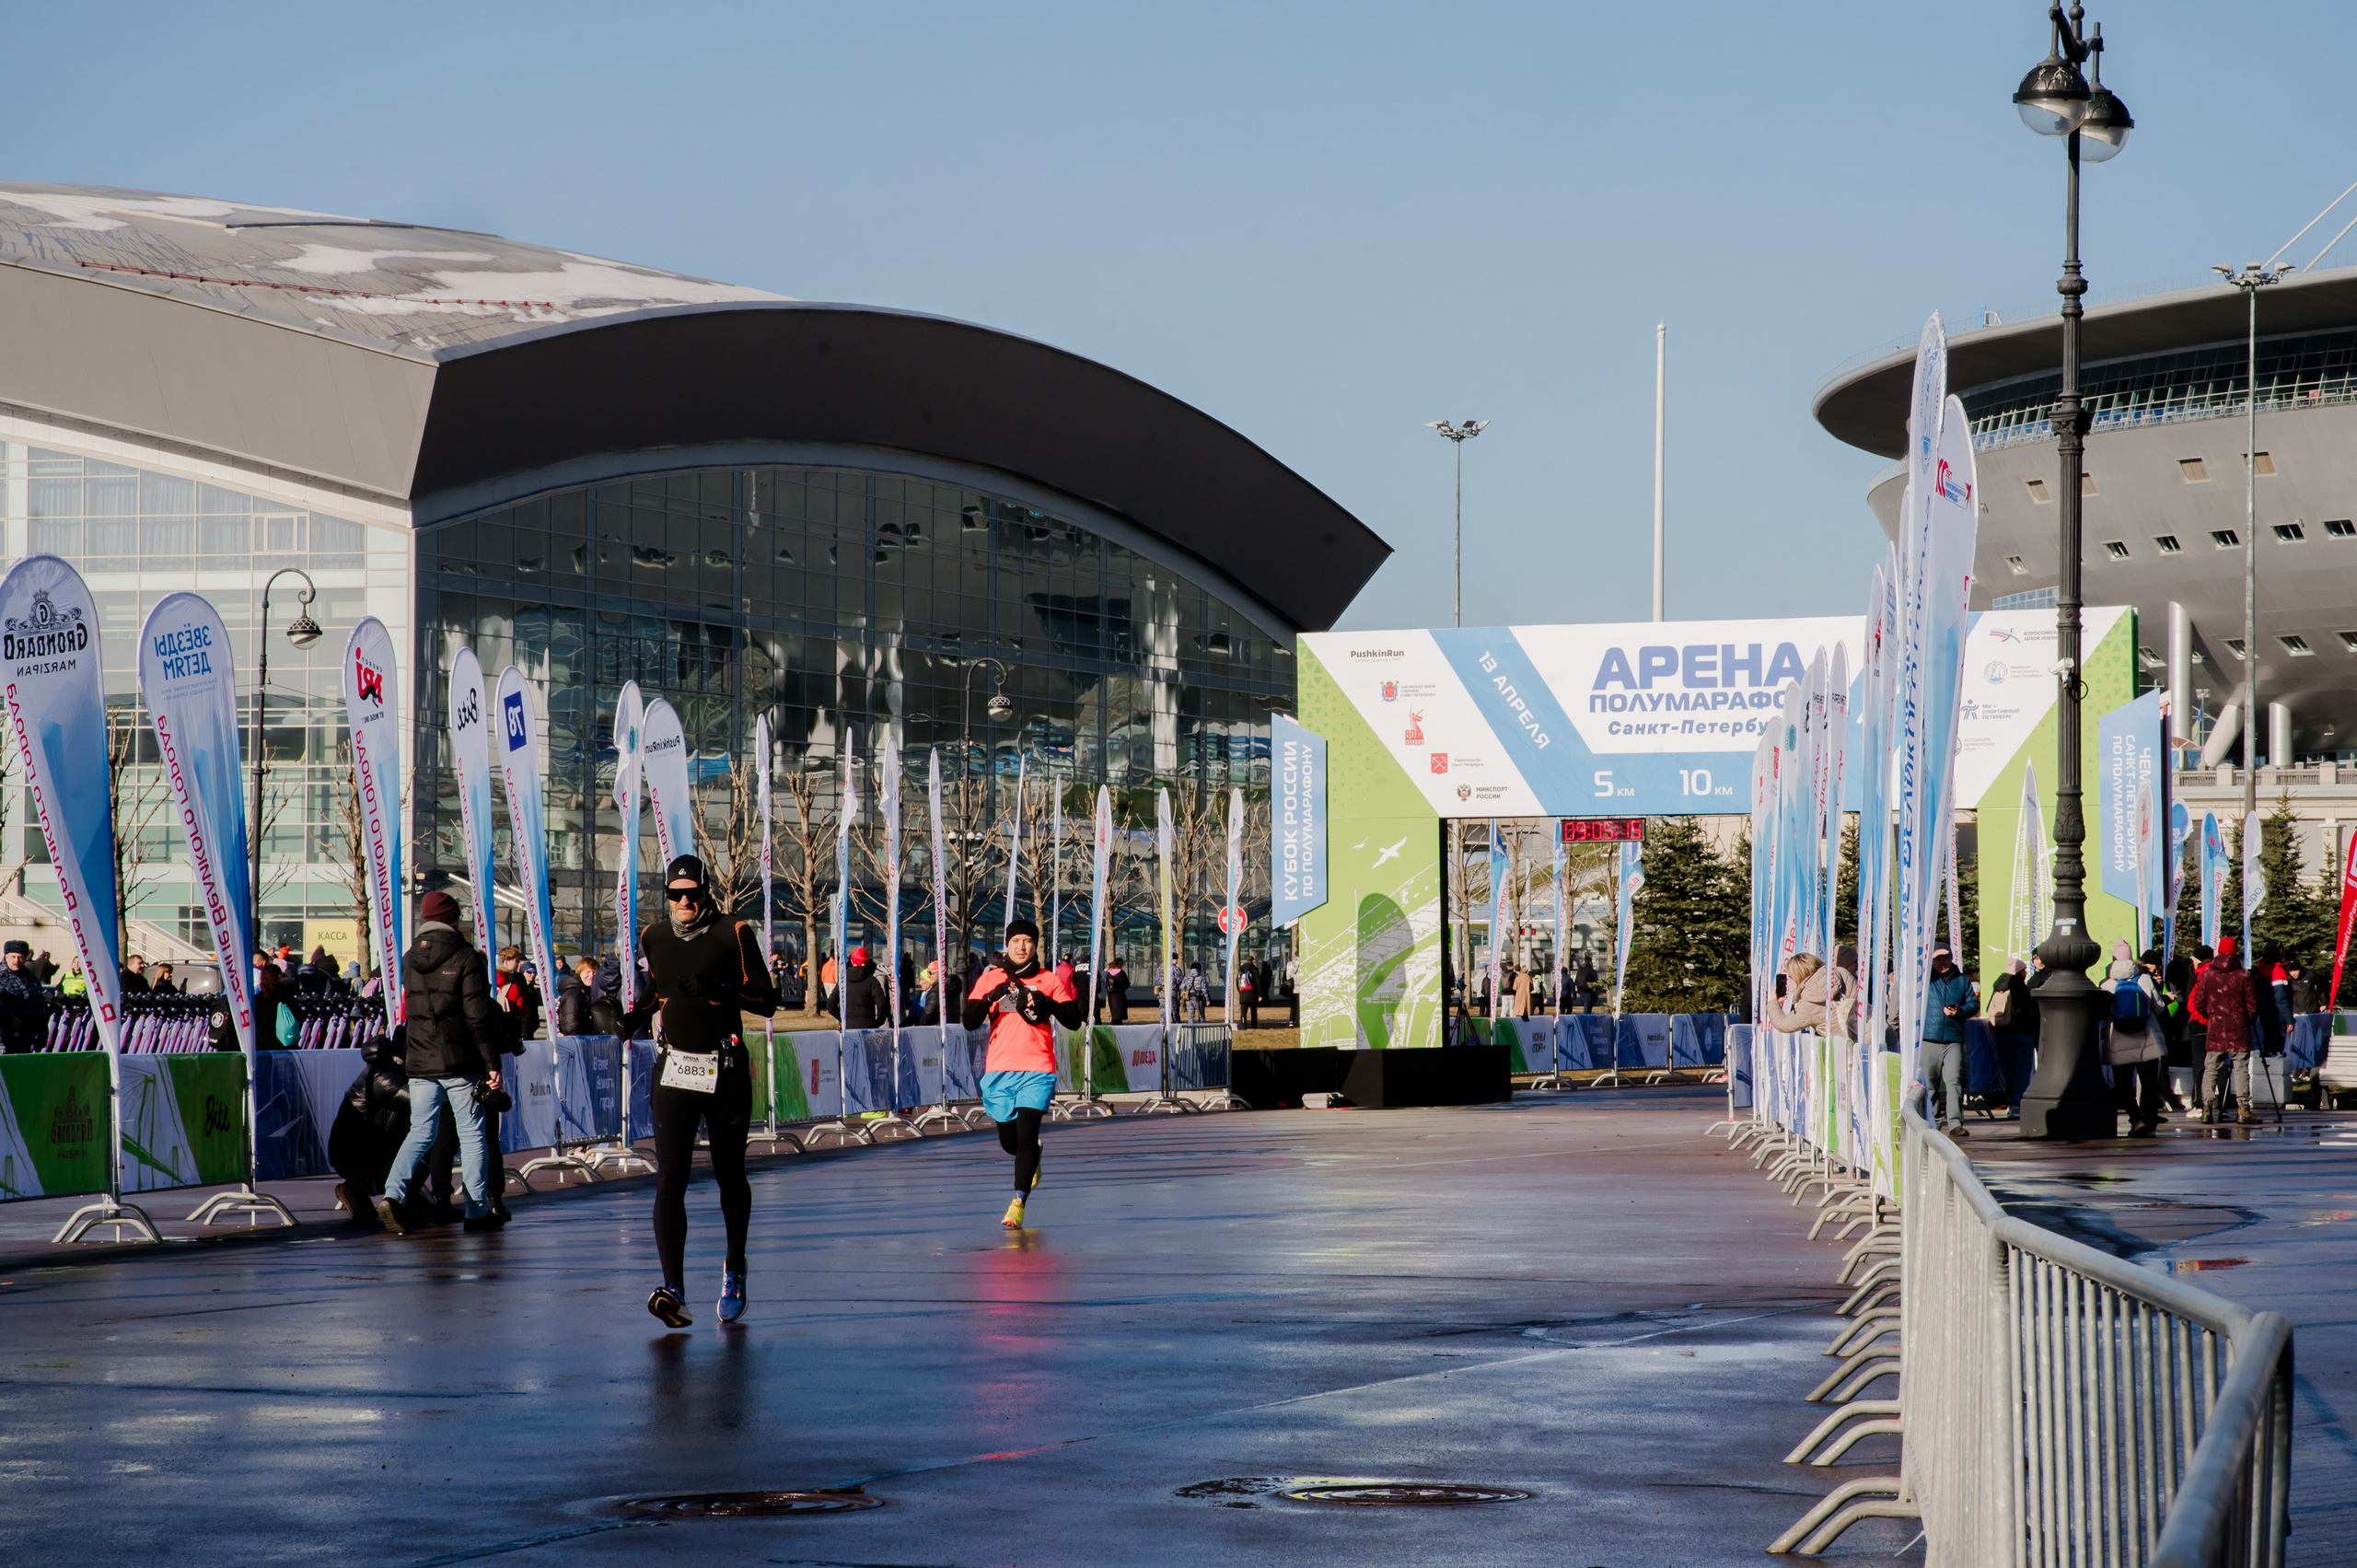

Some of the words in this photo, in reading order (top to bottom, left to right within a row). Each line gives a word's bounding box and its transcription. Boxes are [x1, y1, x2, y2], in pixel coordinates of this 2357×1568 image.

[1350, 648, 1404, 658] PushkinRun
[1592, 642, 1805, 691] АРЕНА
[1478, 650, 1497, 673] 13
[1493, 675, 1551, 749] АПРЕЛЯ
[1589, 690, 1784, 713] ПОЛУМАРАФО
[1405, 728, 1416, 739] 80
[1608, 717, 1769, 737] Санкт-Петербу
[2113, 735, 2123, 755] ПО
[1283, 740, 1297, 825] РОССИИ
[1594, 771, 1614, 796] 5
[1678, 769, 1712, 796] 10
[1302, 744, 1313, 873] ПОЛУМАРАФОНУ
[2125, 734, 2138, 871] САНКТ-ПЕТЕРБУРГА
[2113, 758, 2125, 873] ПОЛУМАРАФОНУ
[1283, 829, 1298, 901] КУБОК
[1303, 875, 1313, 897] ПО
[318, 931, 348, 940] КАССА
[1024, 1007, 1038, 1021] FILA
[677, 1064, 705, 1076] 6883
[204, 1093, 230, 1138] Bite
